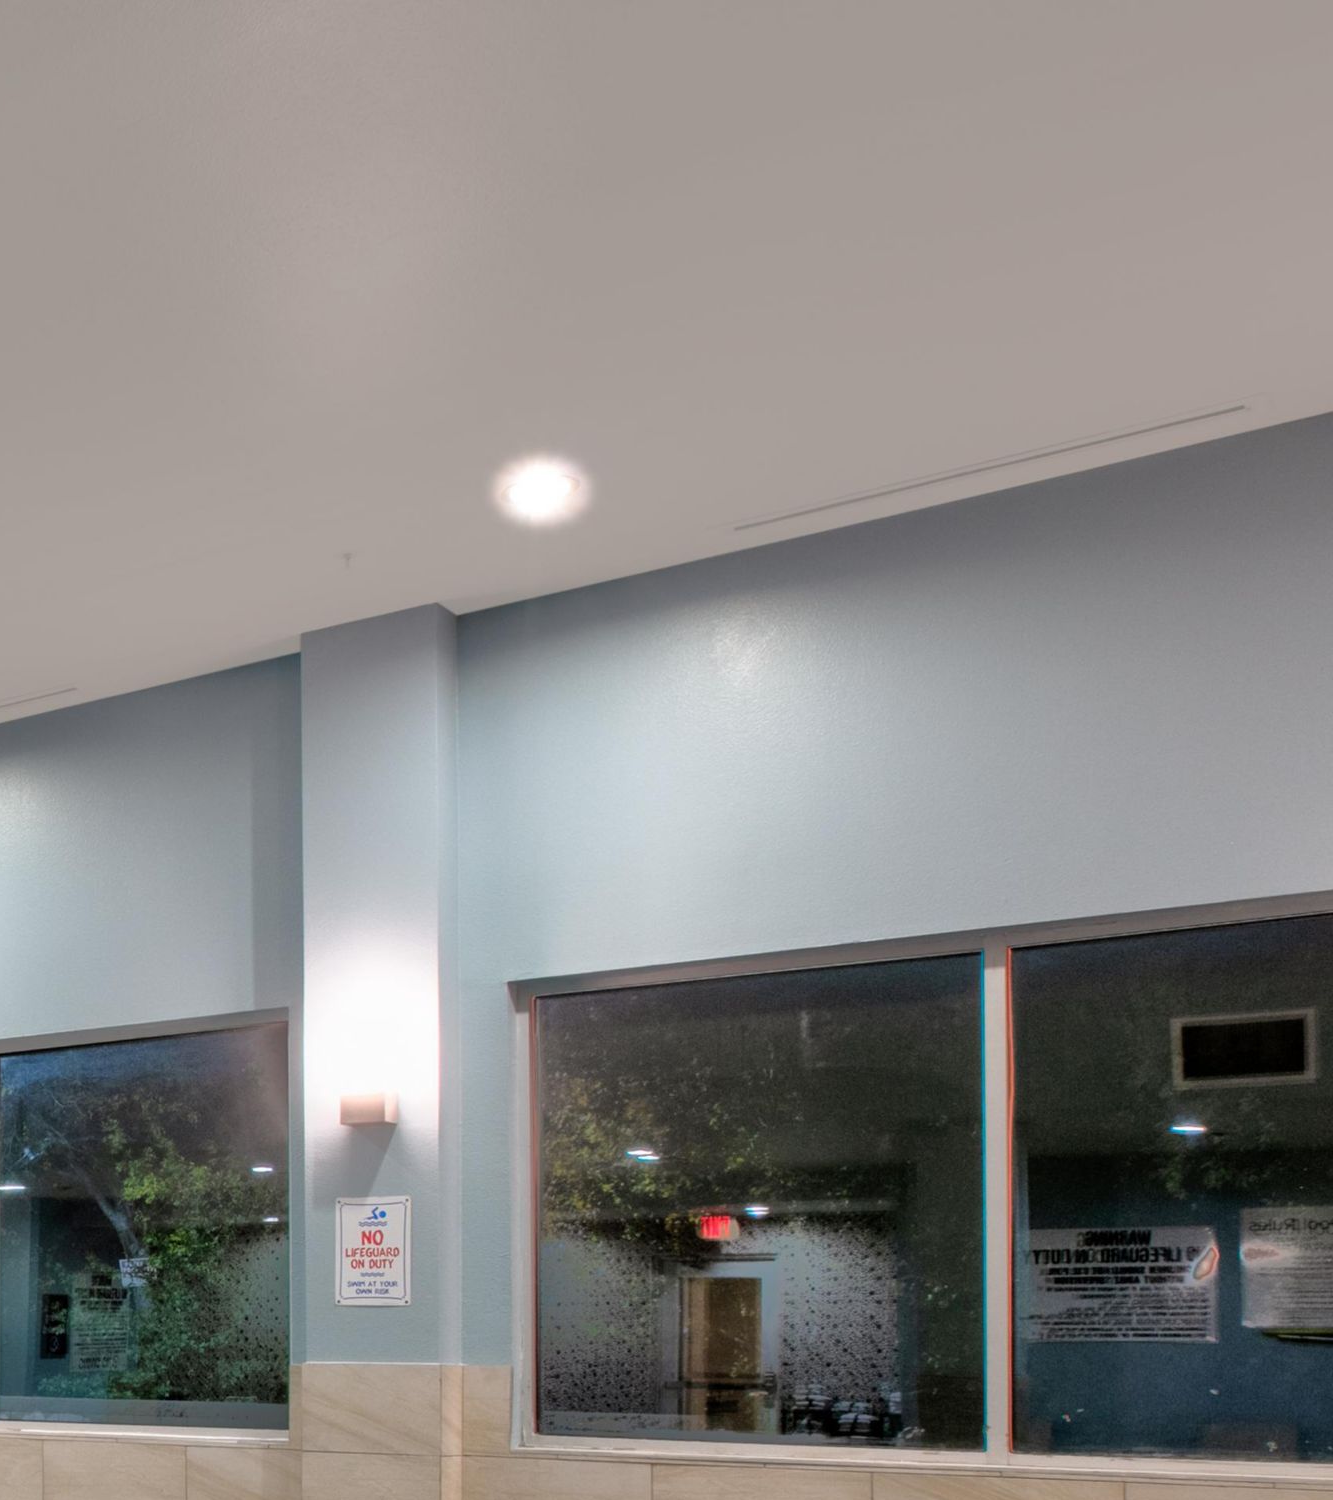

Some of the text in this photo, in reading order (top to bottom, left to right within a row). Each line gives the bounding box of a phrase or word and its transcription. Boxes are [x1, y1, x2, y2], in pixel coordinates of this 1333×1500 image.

[361, 1230, 384, 1246] NO
[345, 1247, 400, 1258] LIFEGUARD
[350, 1259, 394, 1269] ON DUTY
